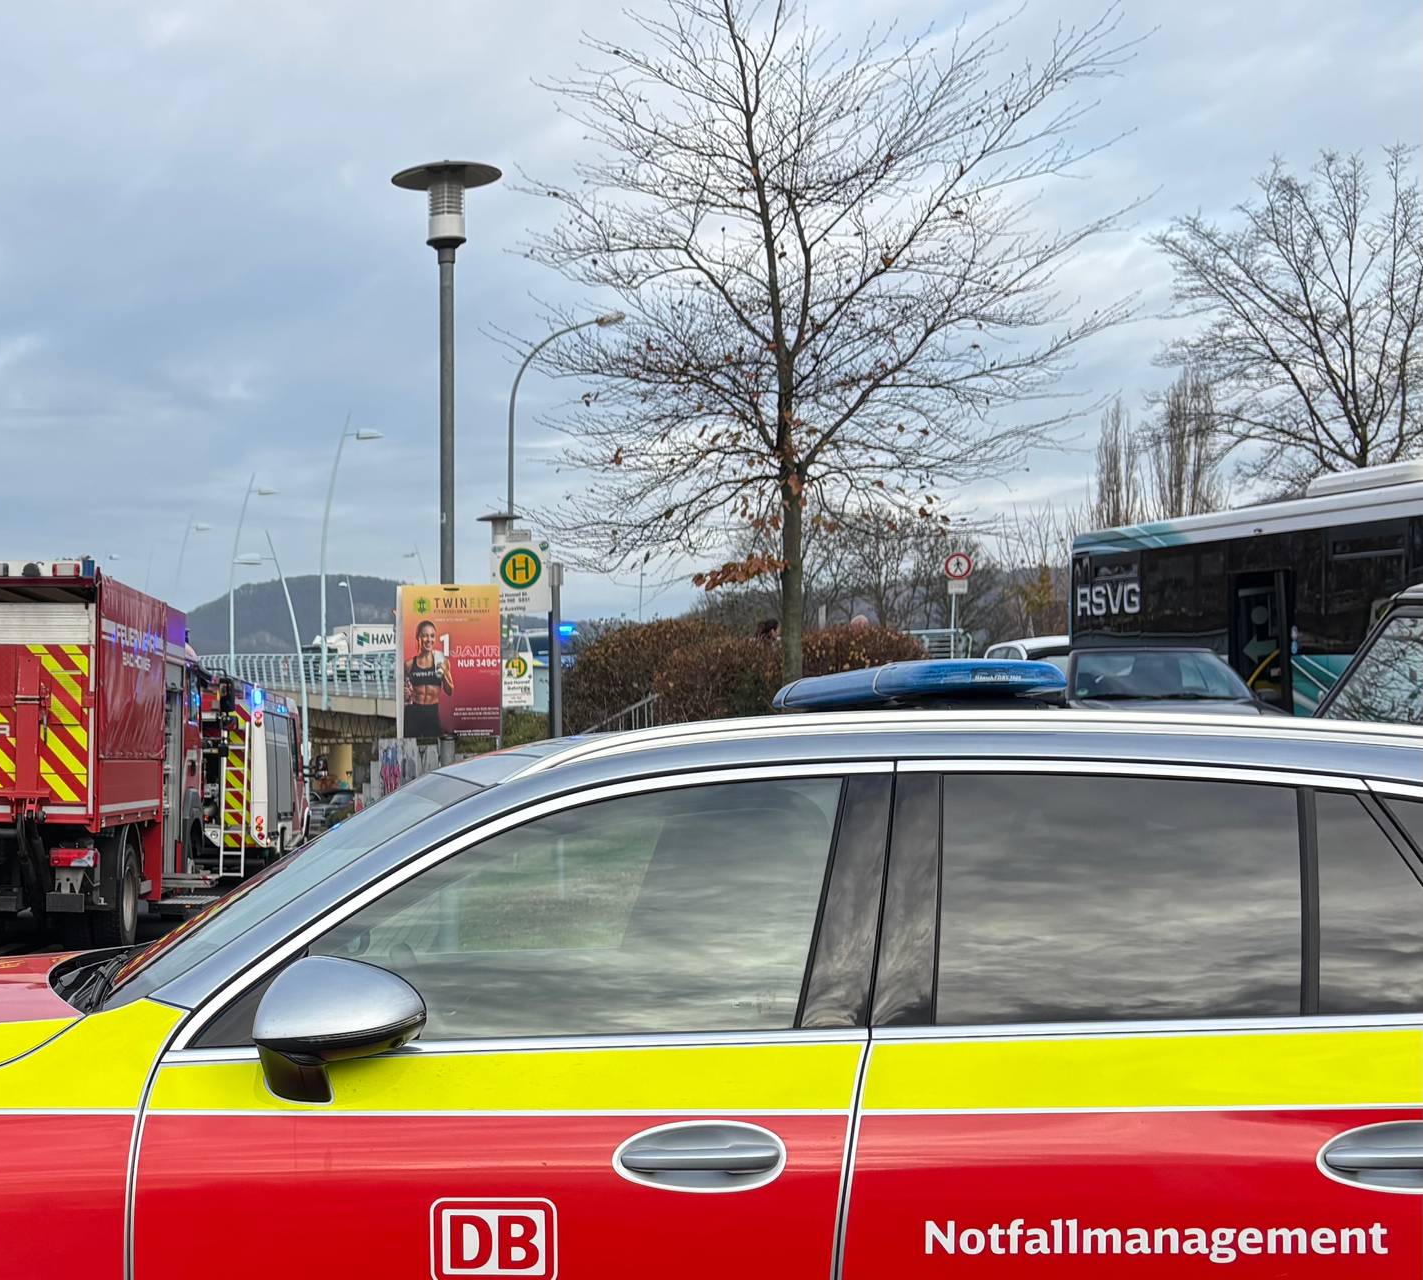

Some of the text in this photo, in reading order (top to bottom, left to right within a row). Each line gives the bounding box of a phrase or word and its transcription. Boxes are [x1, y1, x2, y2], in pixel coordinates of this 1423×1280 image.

[511, 556, 530, 580] H
[1077, 582, 1141, 617] RSVG
[440, 634, 500, 657] 1 JAHR
[457, 659, 475, 668] NUR
[449, 1214, 540, 1270] DB
[924, 1218, 1389, 1264] Notfallmanagement
